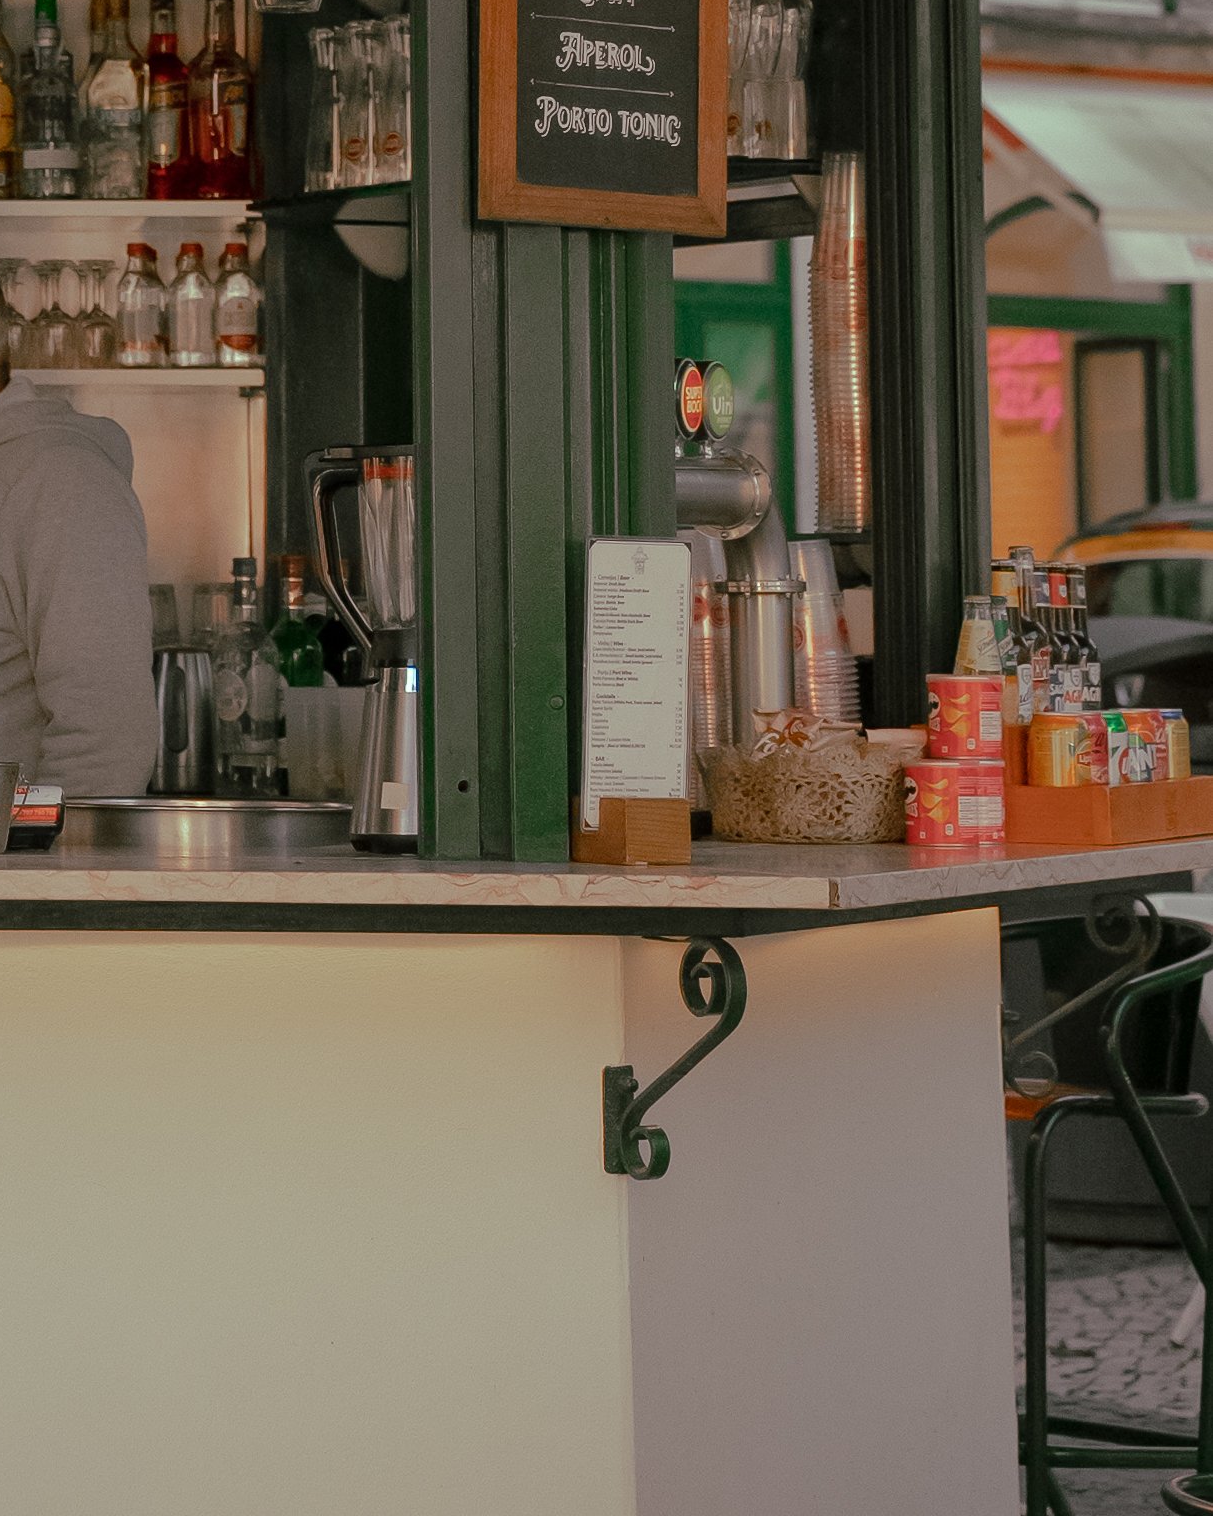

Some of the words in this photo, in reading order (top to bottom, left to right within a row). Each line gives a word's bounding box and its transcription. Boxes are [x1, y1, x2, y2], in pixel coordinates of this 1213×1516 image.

[555, 31, 656, 75] APEROL
[534, 95, 613, 138] PORTO
[617, 109, 681, 147] TONIC
